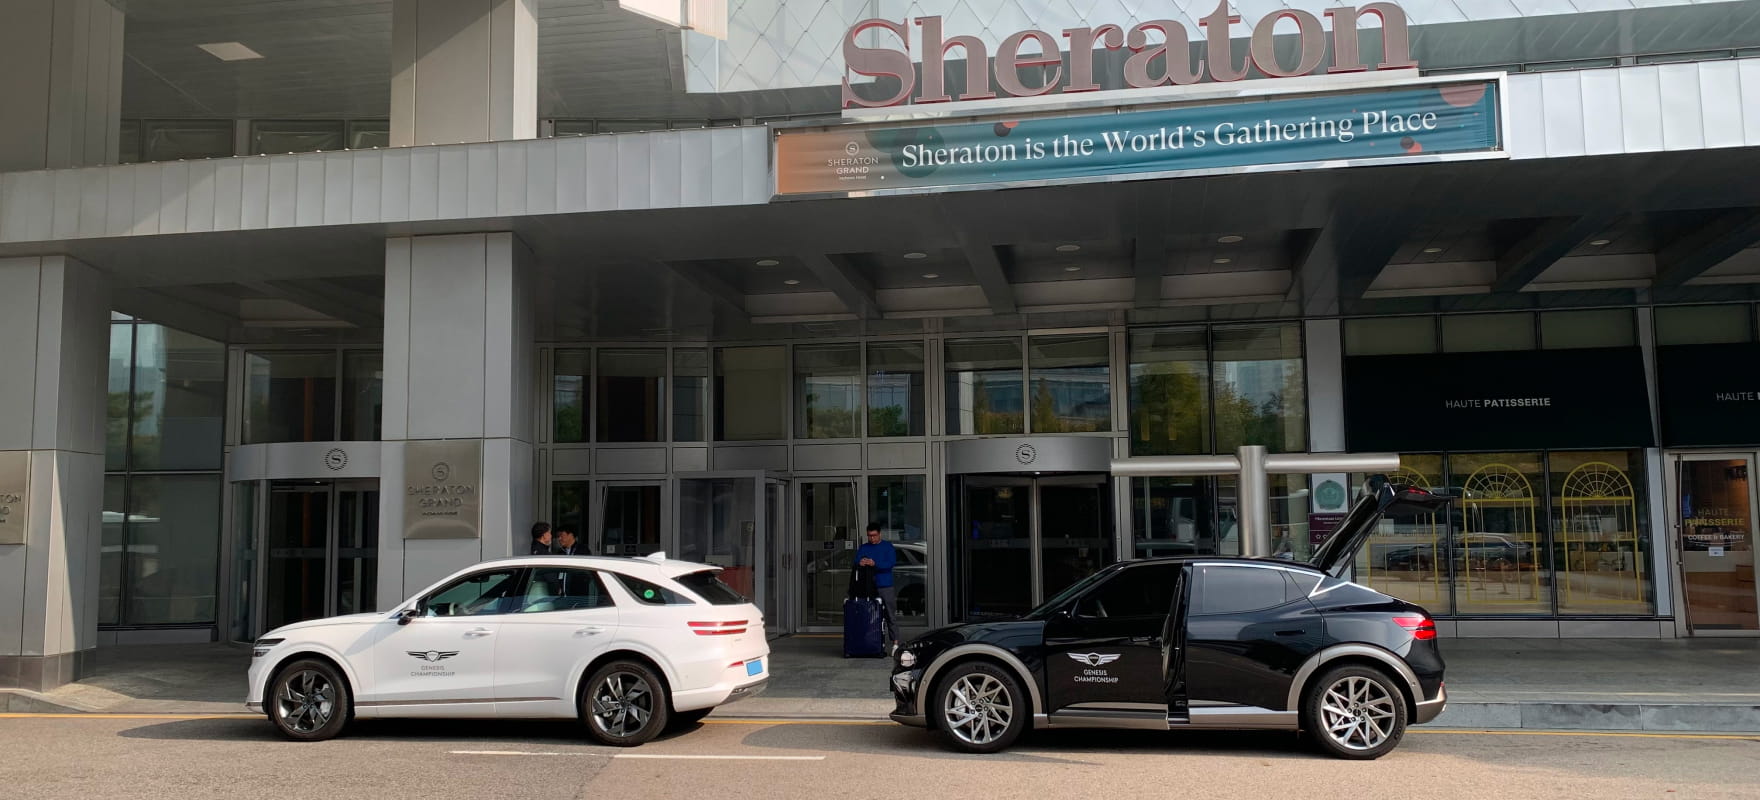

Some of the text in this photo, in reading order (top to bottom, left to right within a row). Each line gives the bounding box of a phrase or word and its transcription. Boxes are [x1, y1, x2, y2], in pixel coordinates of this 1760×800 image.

[841, 0, 1419, 109] Sheraton
[902, 143, 1017, 168] Sheraton
[1024, 138, 1046, 160] is
[1053, 134, 1095, 158] the
[1213, 116, 1355, 147] Gathering
[1361, 110, 1438, 135] Place
[827, 156, 879, 167] SHERATON
[836, 166, 869, 175] GRAND
[1716, 391, 1755, 401] HAUTE
[1445, 397, 1551, 409] HAUTE PATISSERIE
[407, 483, 476, 496] SHERATON
[419, 497, 464, 508] GRAND
[1720, 533, 1745, 541] BAKERY
[1073, 675, 1119, 683] CHAMPIONSHIP
